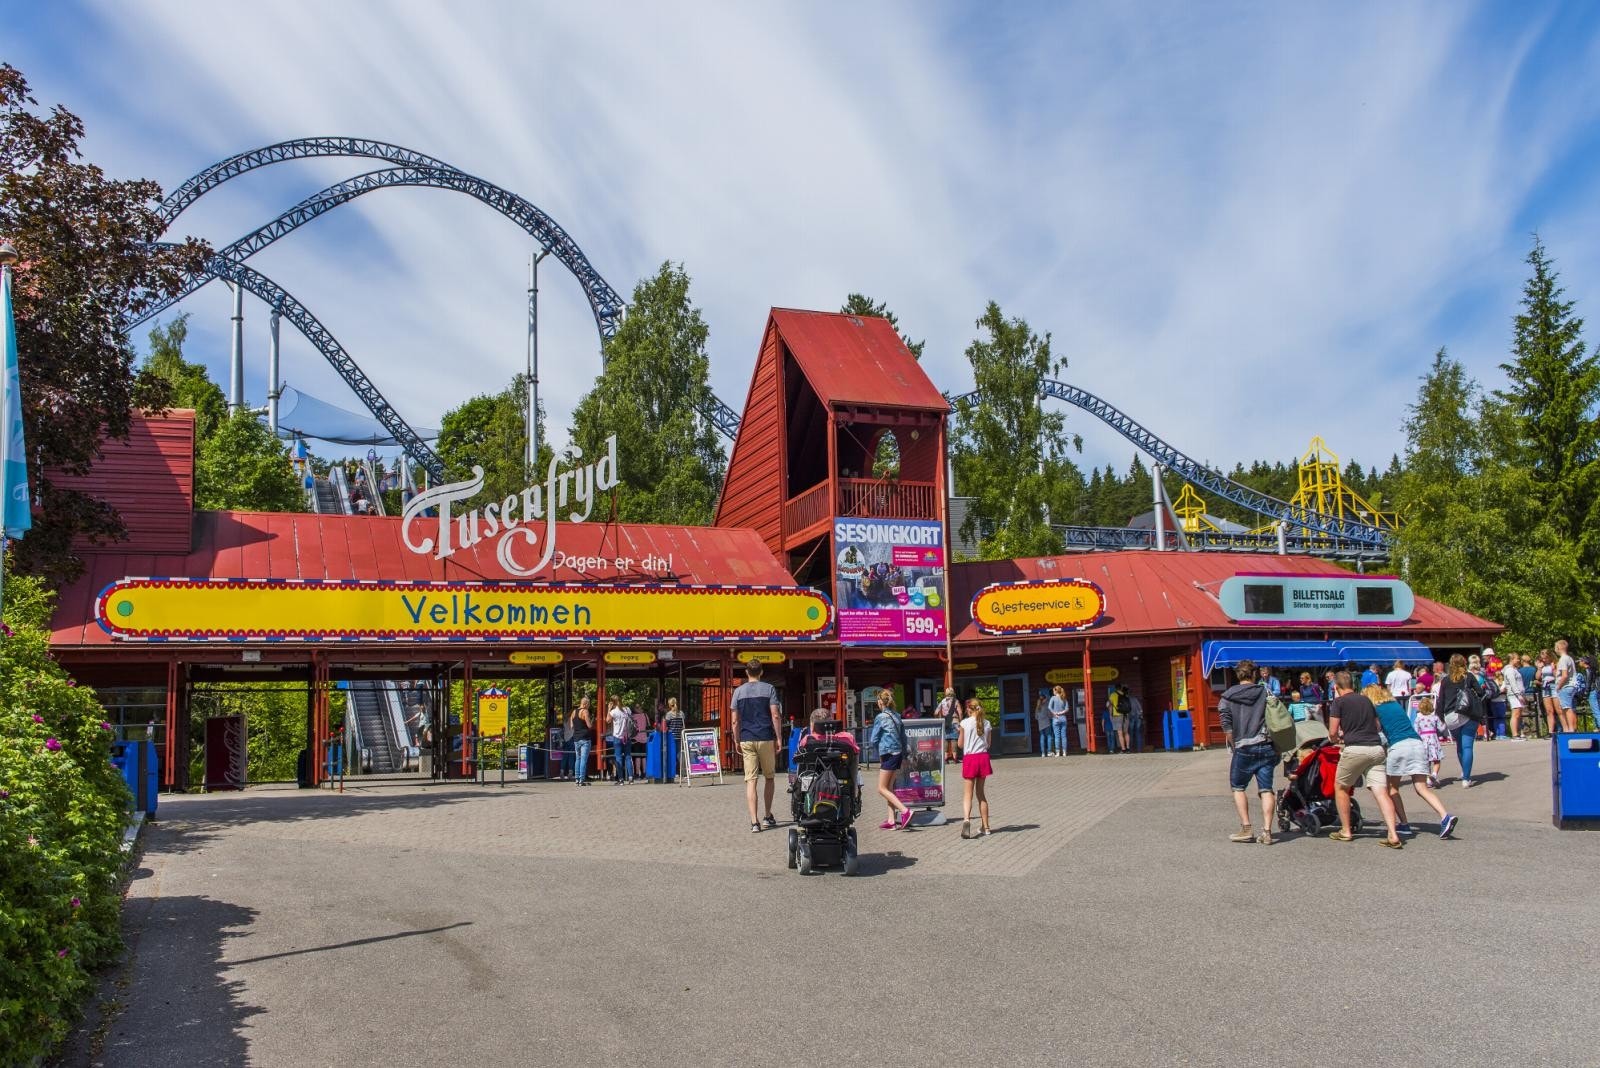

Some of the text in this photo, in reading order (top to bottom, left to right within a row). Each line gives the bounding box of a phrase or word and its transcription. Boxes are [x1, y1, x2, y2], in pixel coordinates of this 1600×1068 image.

[401, 434, 620, 577] Tusenfryd
[835, 523, 940, 545] SESONGKORT
[552, 551, 673, 573] Dagen er din!
[1293, 589, 1345, 601] BILLETTSALG
[401, 592, 592, 626] Velkommen
[991, 599, 1071, 616] Gjesteservice
[1293, 601, 1312, 609] Billetter
[1313, 602, 1319, 610] og
[906, 617, 942, 636] 599,-
[905, 728, 941, 737] ONGKORT
